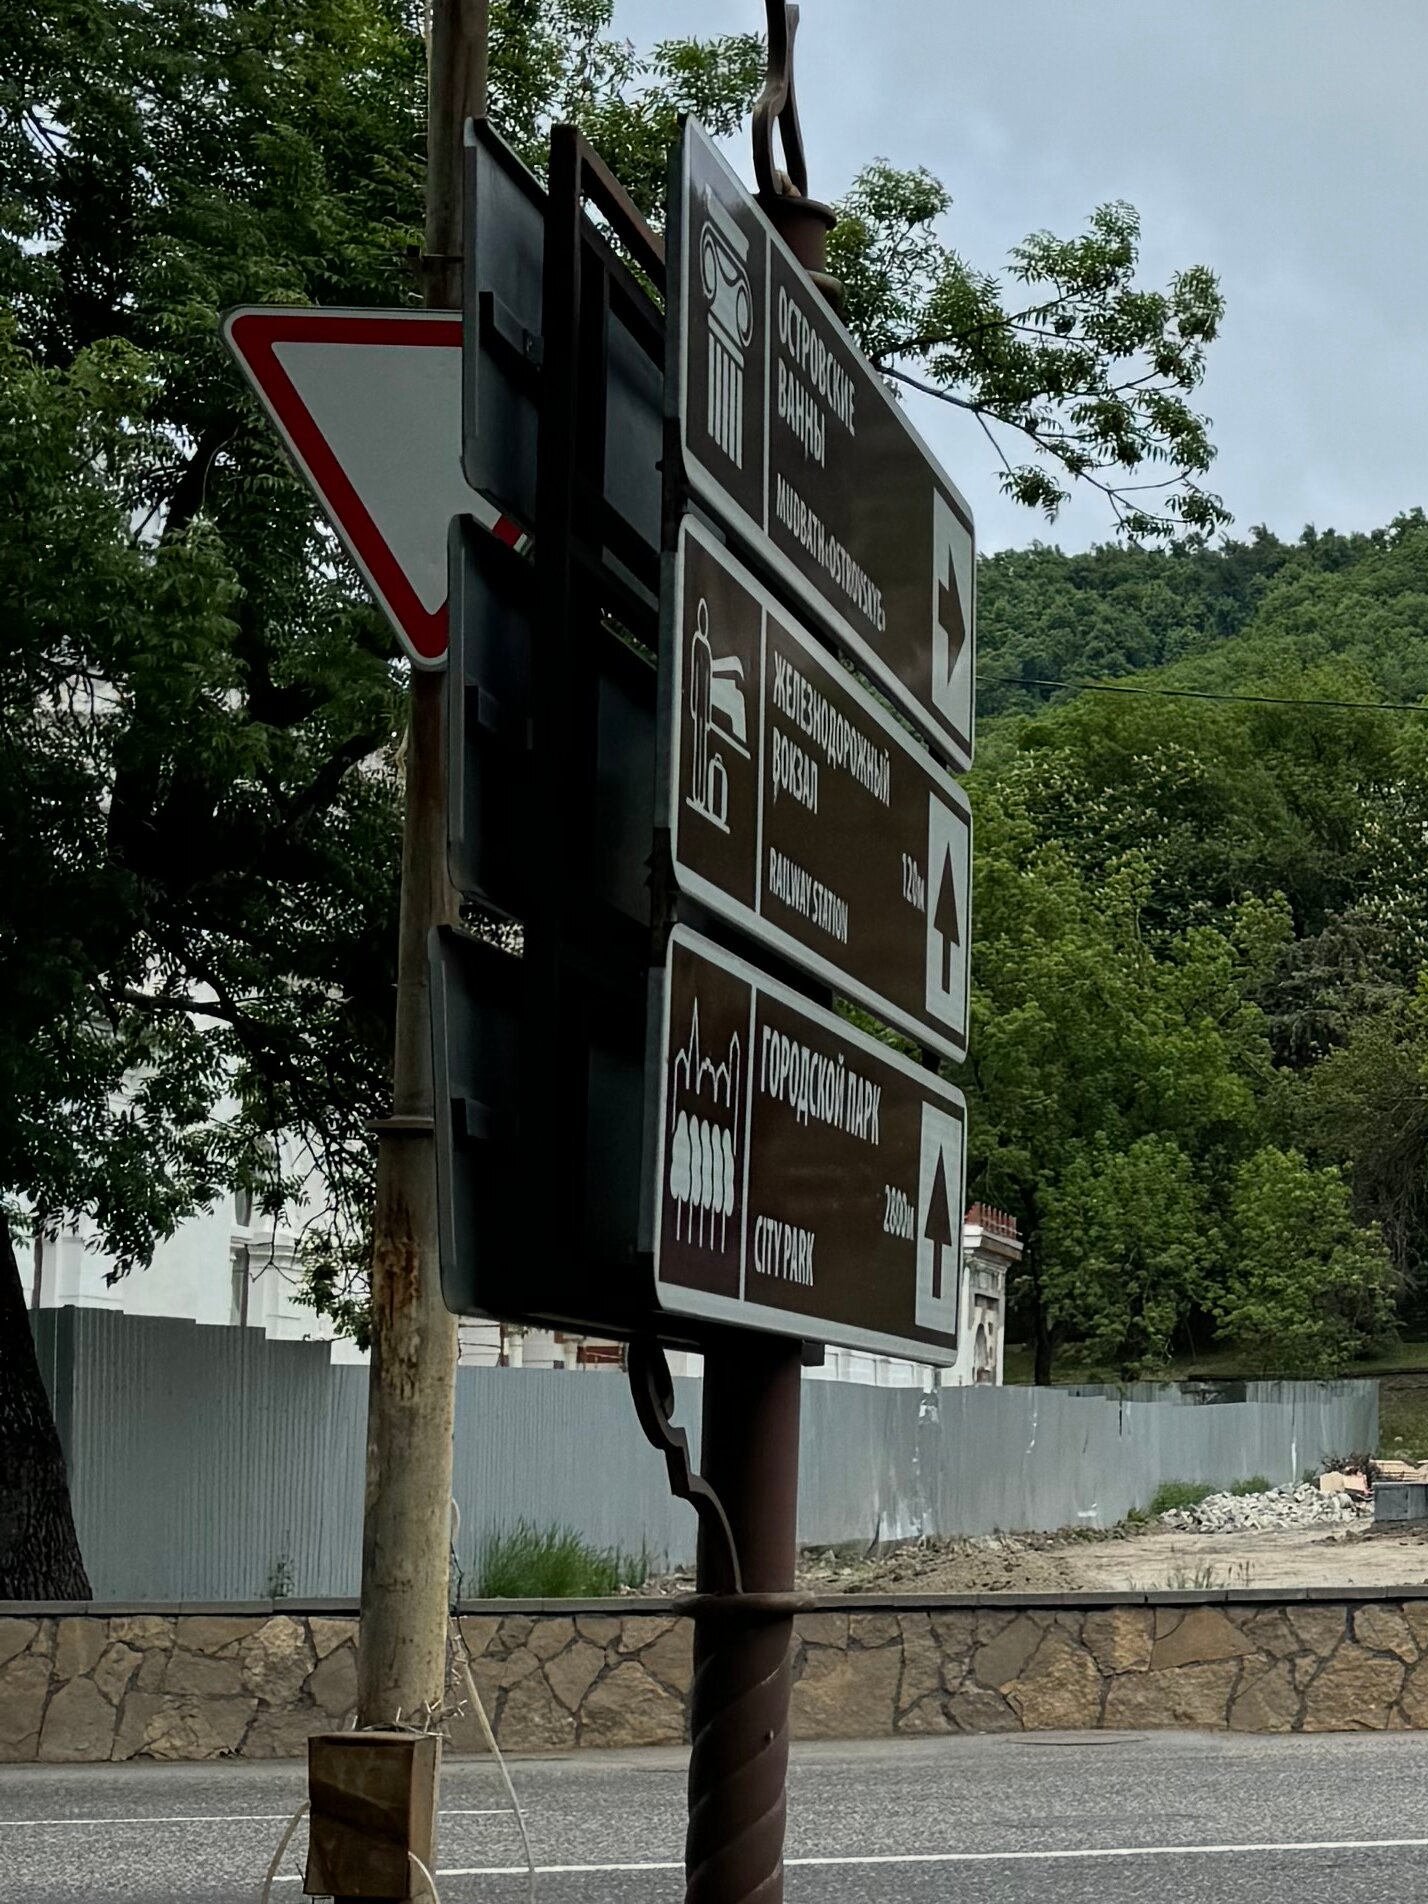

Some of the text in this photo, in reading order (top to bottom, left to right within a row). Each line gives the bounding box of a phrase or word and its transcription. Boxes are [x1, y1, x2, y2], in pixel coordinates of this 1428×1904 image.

[777, 357, 826, 470] ВАННЫ
[778, 285, 856, 437] ОСТРОВСКИЕ
[776, 472, 825, 567] MUDBATH
[772, 726, 818, 815] ВОКЗАЛ
[773, 650, 890, 808] ЖЕЛЕЗНОДОРОЖНЫЙ
[769, 847, 848, 944] RAILWAY STATION
[761, 1024, 881, 1146] ГОРОДСКОЙ ПАРК
[754, 1215, 815, 1286] CITY PARK
